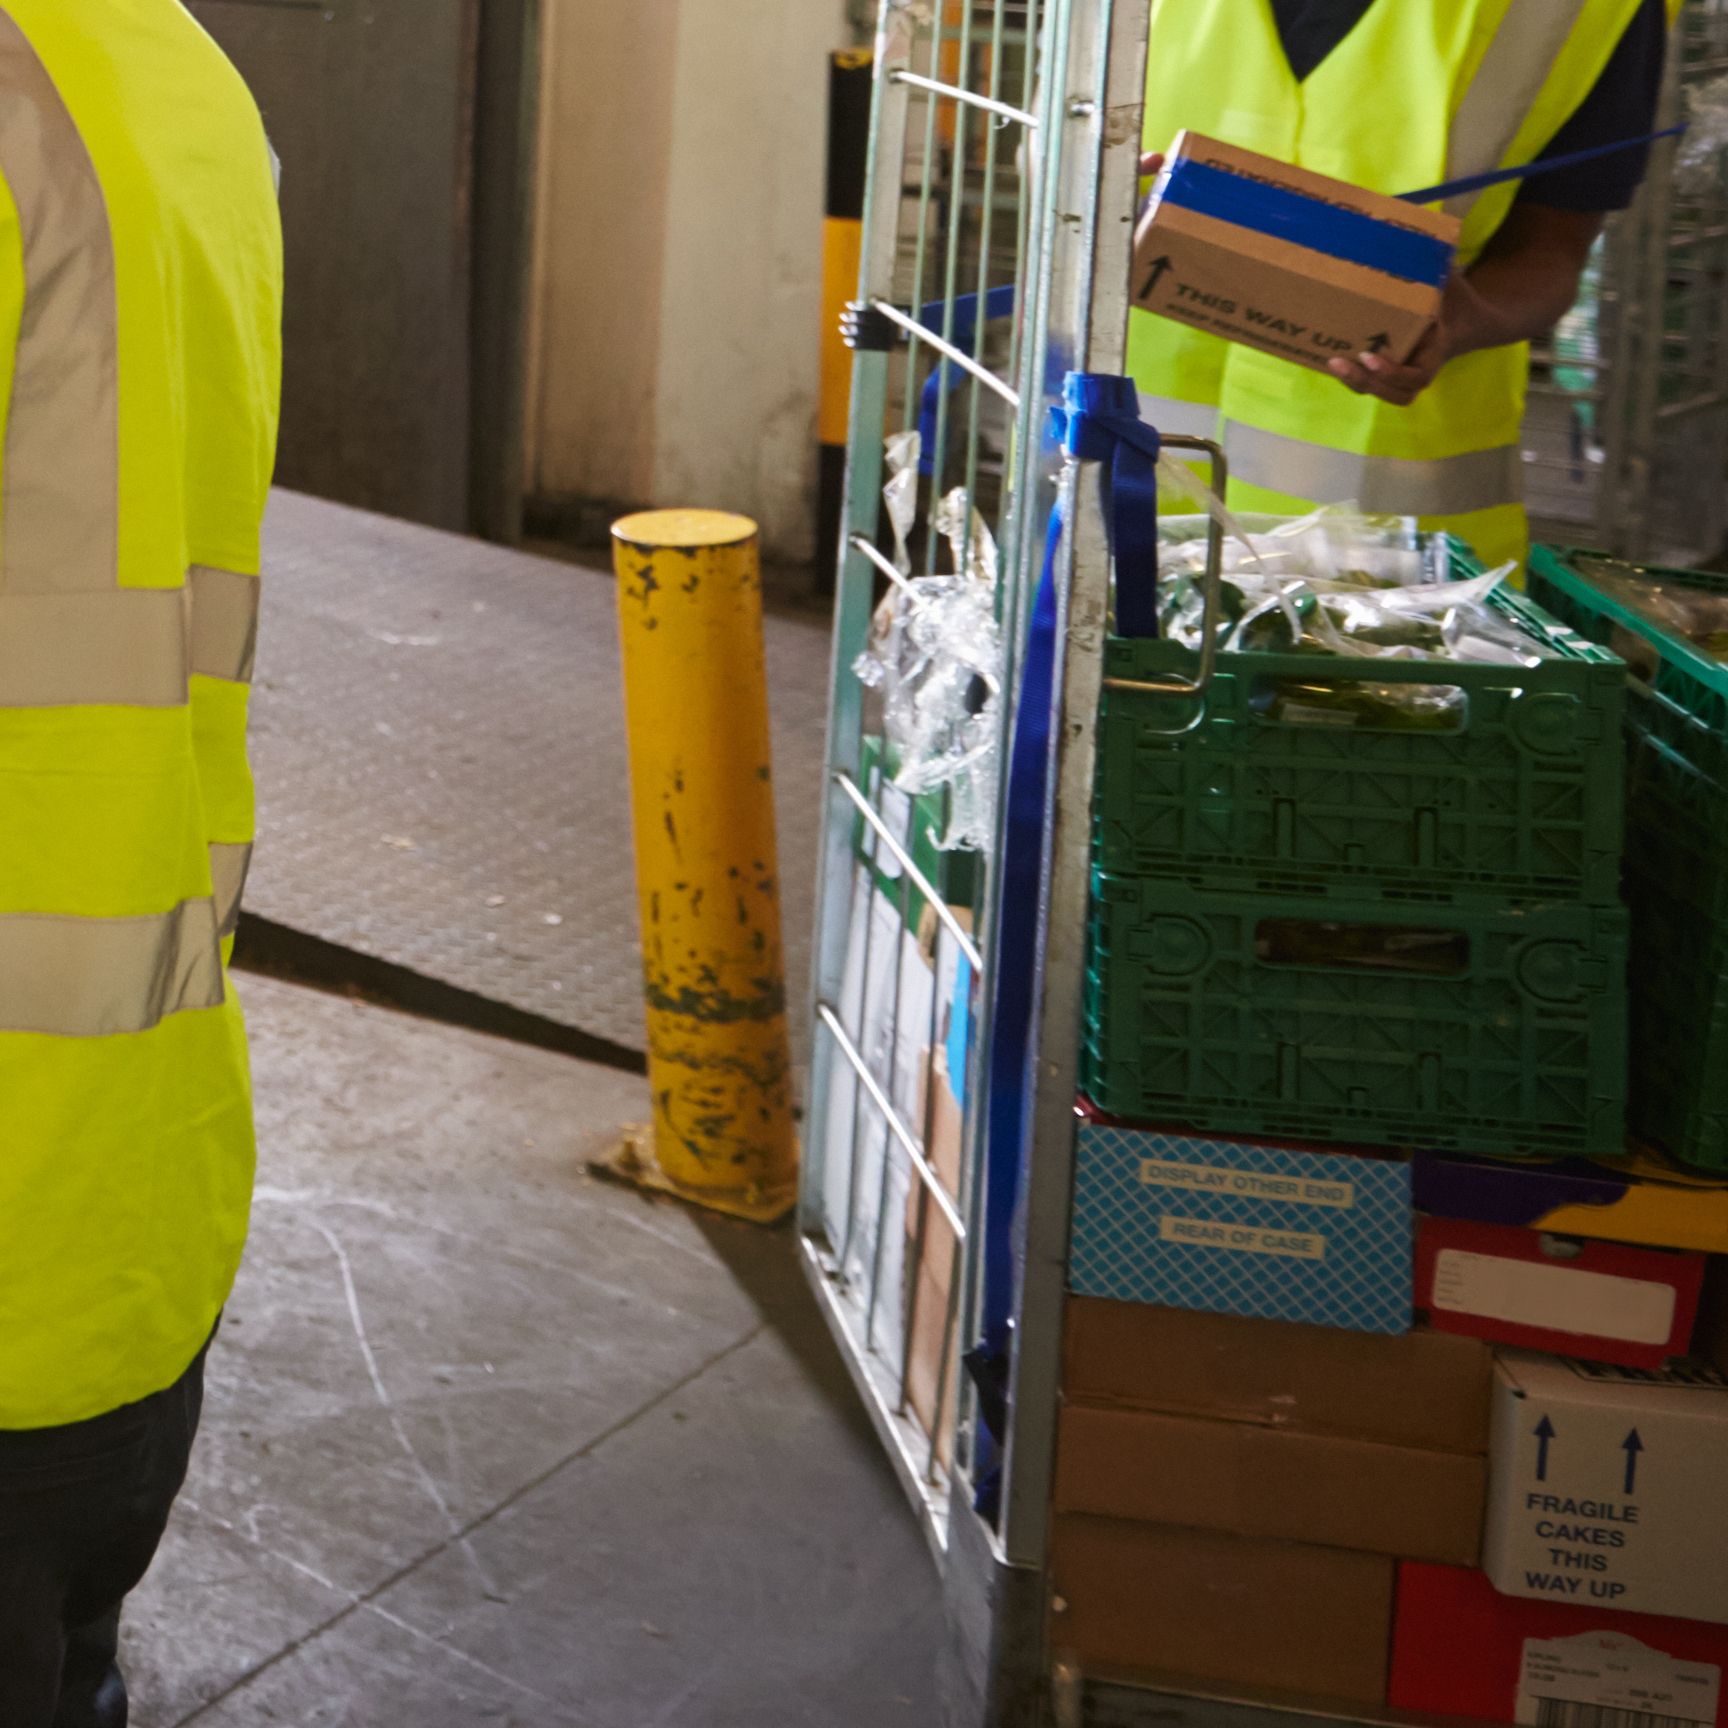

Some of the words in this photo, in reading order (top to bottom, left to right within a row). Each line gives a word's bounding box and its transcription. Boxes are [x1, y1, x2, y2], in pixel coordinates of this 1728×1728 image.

[1174, 282, 1237, 314] THIS
[1245, 305, 1309, 338] WAY
[1310, 330, 1353, 353] UP
[1147, 1165, 1228, 1187] DISPLAY
[1232, 1174, 1298, 1195] OTHER
[1304, 1183, 1344, 1201] END
[1173, 1223, 1226, 1241] REAR
[1230, 1230, 1257, 1245] OF
[1261, 1234, 1314, 1253] CASE
[1526, 1493, 1639, 1524] FRAGILE
[1535, 1520, 1625, 1548] CAKES
[1547, 1548, 1608, 1572] THIS
[1525, 1571, 1583, 1595] WAY
[1589, 1579, 1626, 1599] UP
